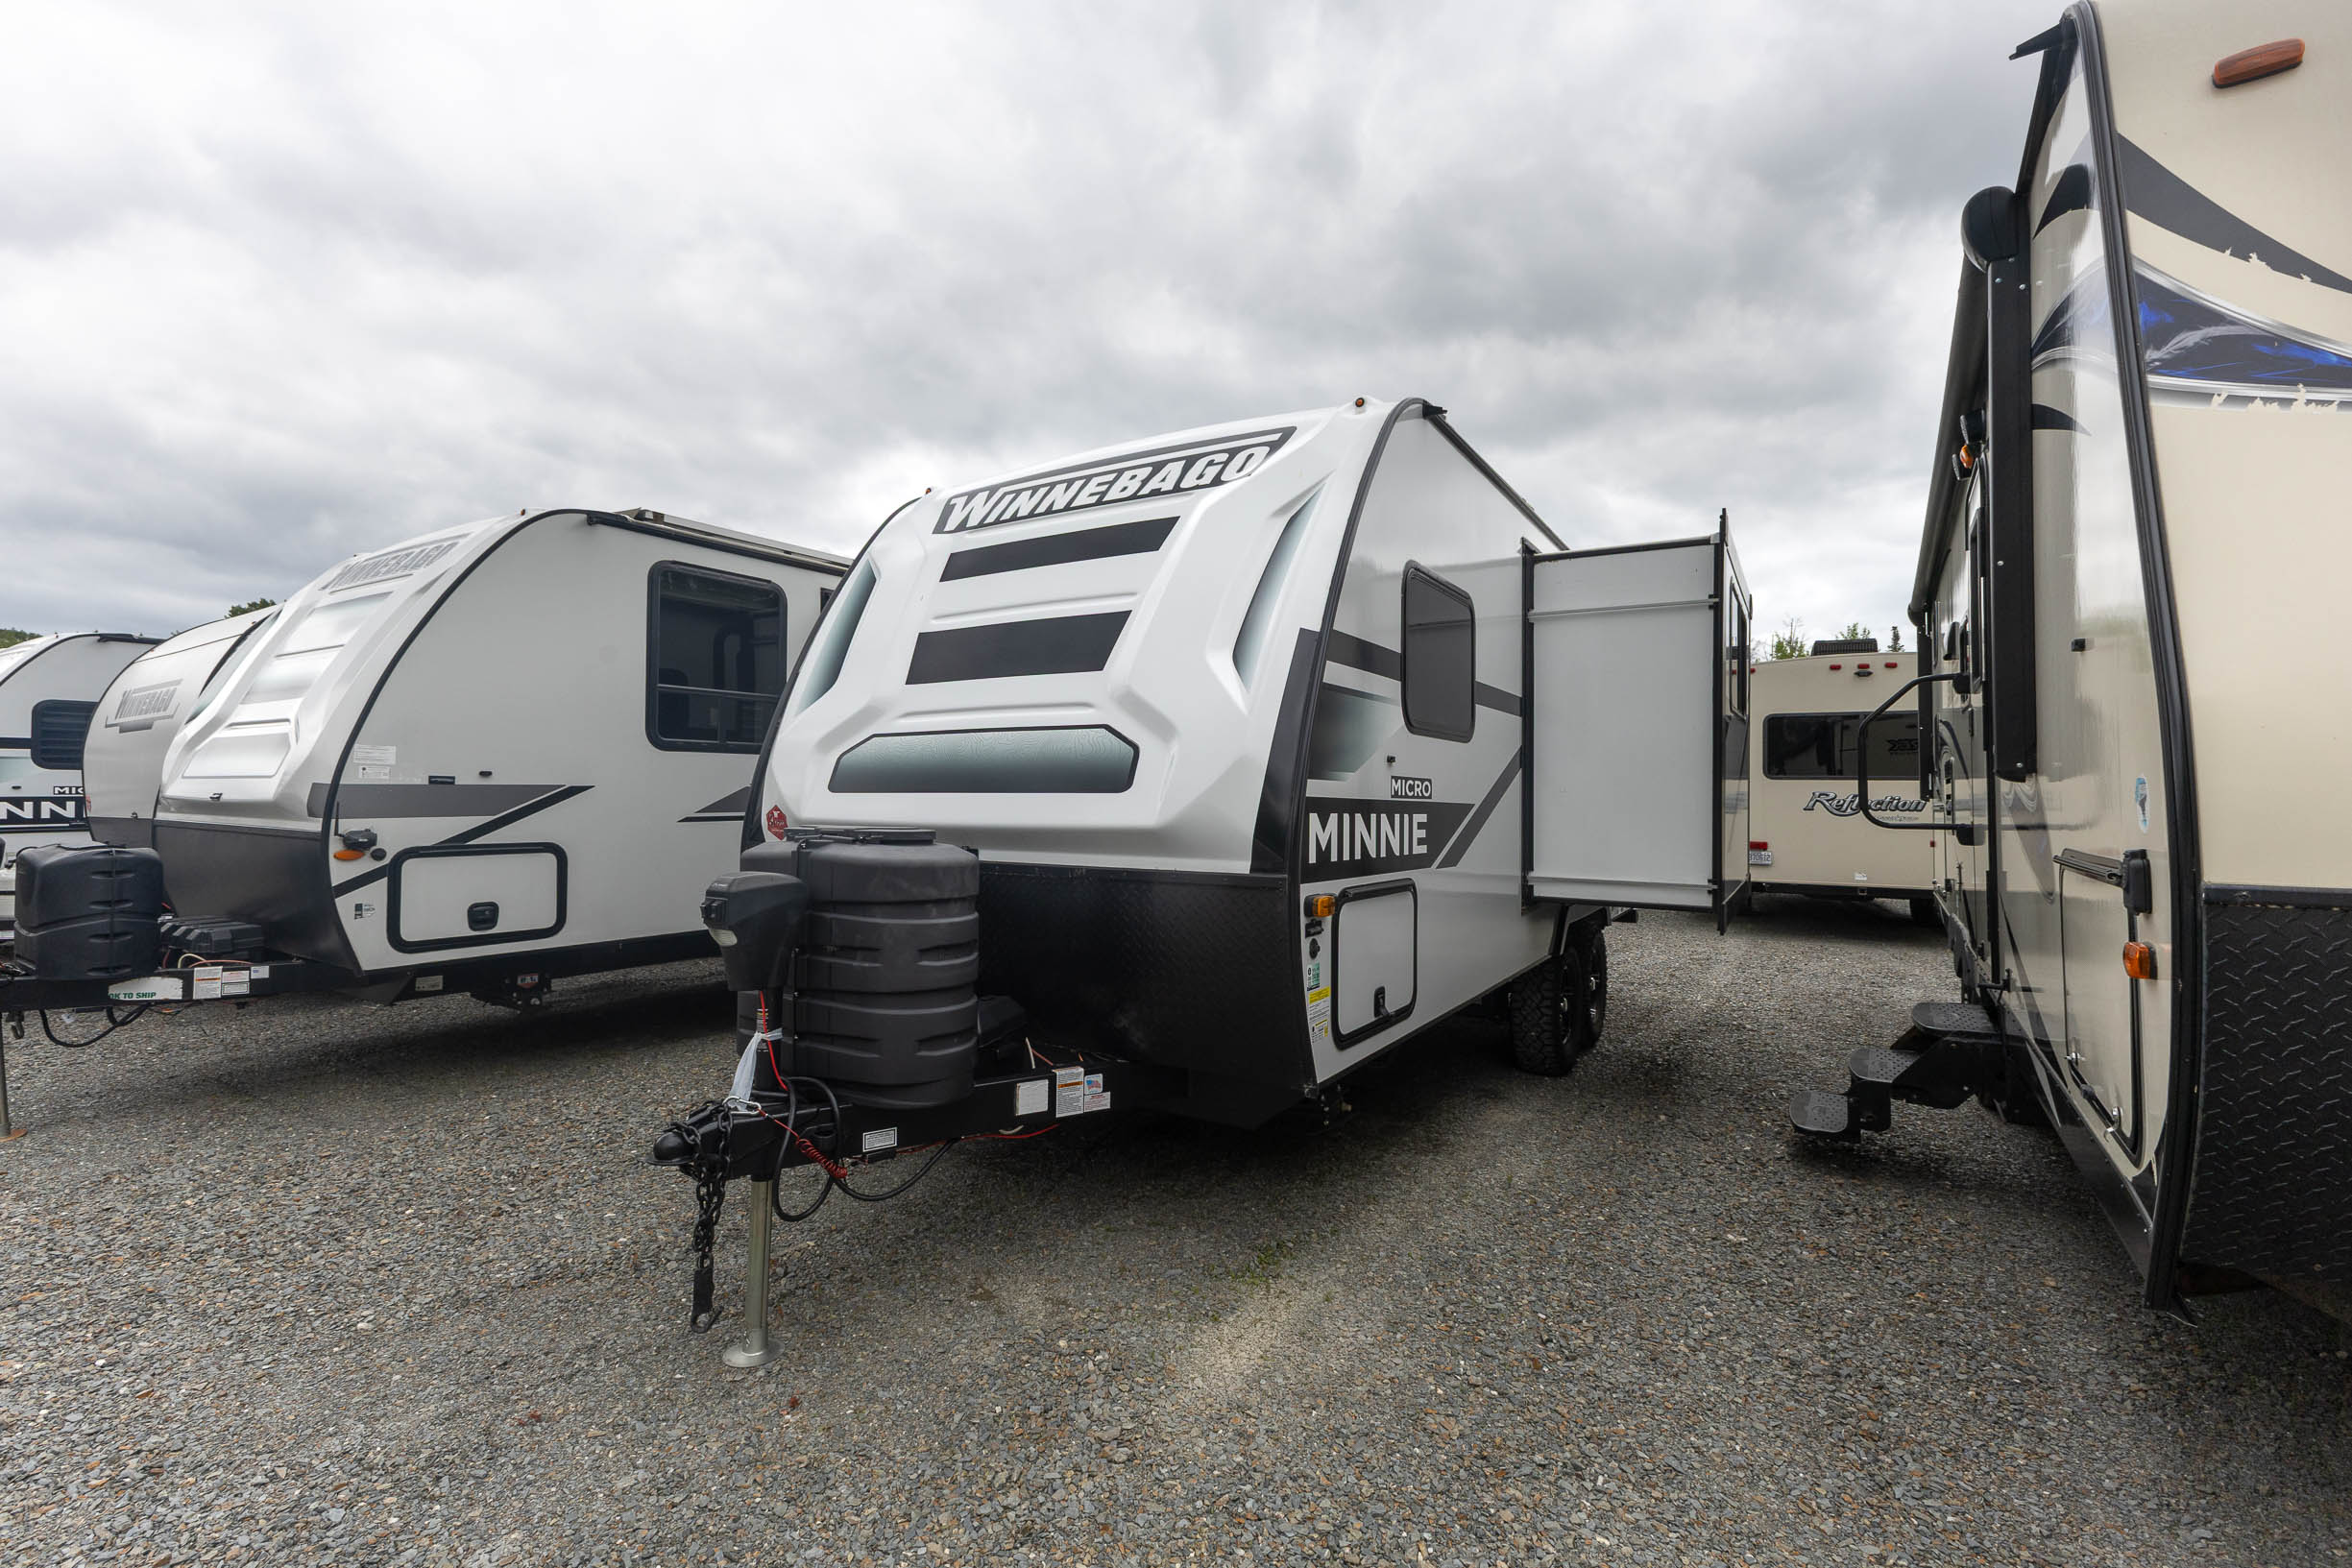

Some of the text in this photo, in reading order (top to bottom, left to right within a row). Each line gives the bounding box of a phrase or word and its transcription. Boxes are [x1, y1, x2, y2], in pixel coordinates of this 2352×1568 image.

[943, 446, 1270, 531] WINNEBAGO
[116, 687, 177, 720] WINNEBAGO
[1392, 779, 1431, 797] MICRO
[0, 801, 86, 819] NN
[1804, 791, 1927, 817] Reflction
[1308, 812, 1428, 863] MINNIE
